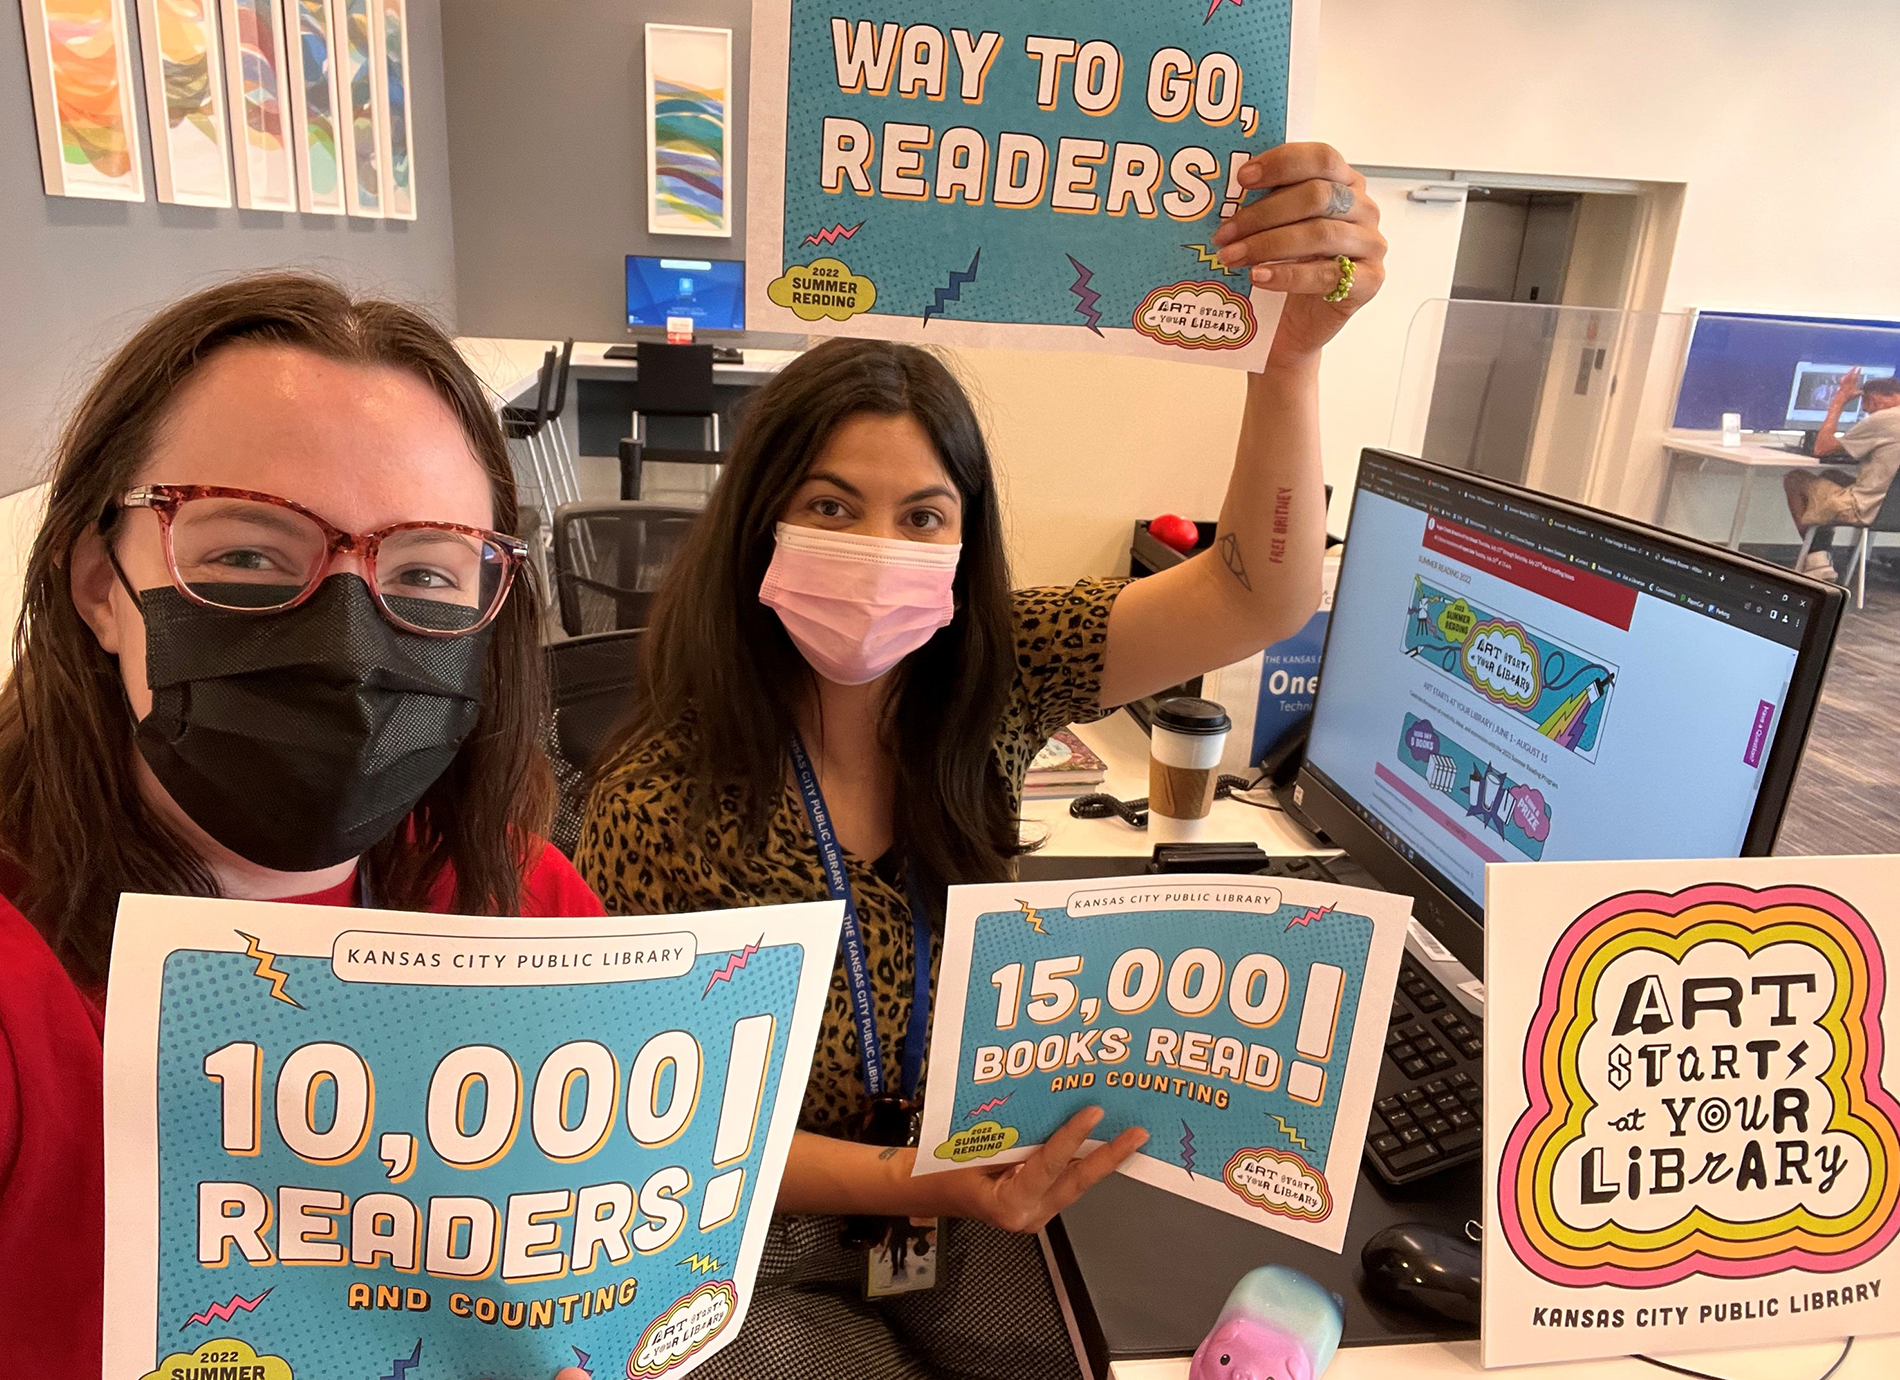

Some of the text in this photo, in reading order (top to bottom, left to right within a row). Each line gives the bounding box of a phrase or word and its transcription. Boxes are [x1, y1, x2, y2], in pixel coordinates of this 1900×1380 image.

[830, 18, 1258, 136] WAY TO GO,
[820, 117, 1252, 222] READERS!
[812, 267, 840, 278] 2022
[792, 277, 858, 294] SUMMER
[792, 292, 856, 308] READING
[1157, 301, 1196, 314] ART
[1269, 486, 1293, 564] FREE BRITNEY
[1418, 555, 1438, 571] SUMMER
[1438, 564, 1459, 580] READING
[1444, 620, 1469, 635] READING
[1446, 610, 1471, 624] SUMMER
[1265, 655, 1281, 664] THE
[1282, 655, 1317, 664] KANSAS
[1477, 639, 1502, 660] ART
[1432, 685, 1450, 703] STARTS
[1455, 699, 1470, 715] YOUR
[1471, 707, 1493, 729] LIBRARY
[1494, 725, 1509, 739] JUNE
[1516, 737, 1540, 758] AUGUST
[1540, 752, 1548, 764] 15
[1517, 797, 1540, 831] PRIZE
[802, 770, 817, 796] CITY
[810, 799, 831, 841] PUBLIC
[824, 842, 845, 891] LIBRARY
[1074, 892, 1272, 909] KANSAS CITY PUBLIC LIBRARY
[843, 914, 856, 938] THE
[347, 944, 686, 970] KANSAS CITY PUBLIC LIBRARY
[847, 940, 865, 988] KANSAS
[856, 989, 870, 1016] CITY
[1611, 973, 1817, 1037] ART
[862, 1018, 875, 1059] PUBLIC
[973, 1026, 1131, 1084] BOOKS
[1051, 1070, 1230, 1110] AND COUNTING
[971, 1127, 992, 1135] 2022
[1608, 1107, 1646, 1132] at
[953, 1142, 1002, 1156] READING
[954, 1132, 1006, 1147] SUMMER
[1245, 1162, 1278, 1180] ART
[348, 1277, 638, 1330] AND COUNTING
[1532, 1279, 1882, 1328] KANSAS CITY PUBLIC LIBRARY
[651, 1318, 688, 1346] ART
[200, 1351, 239, 1363] 2022
[171, 1366, 265, 1380] SUMMER
